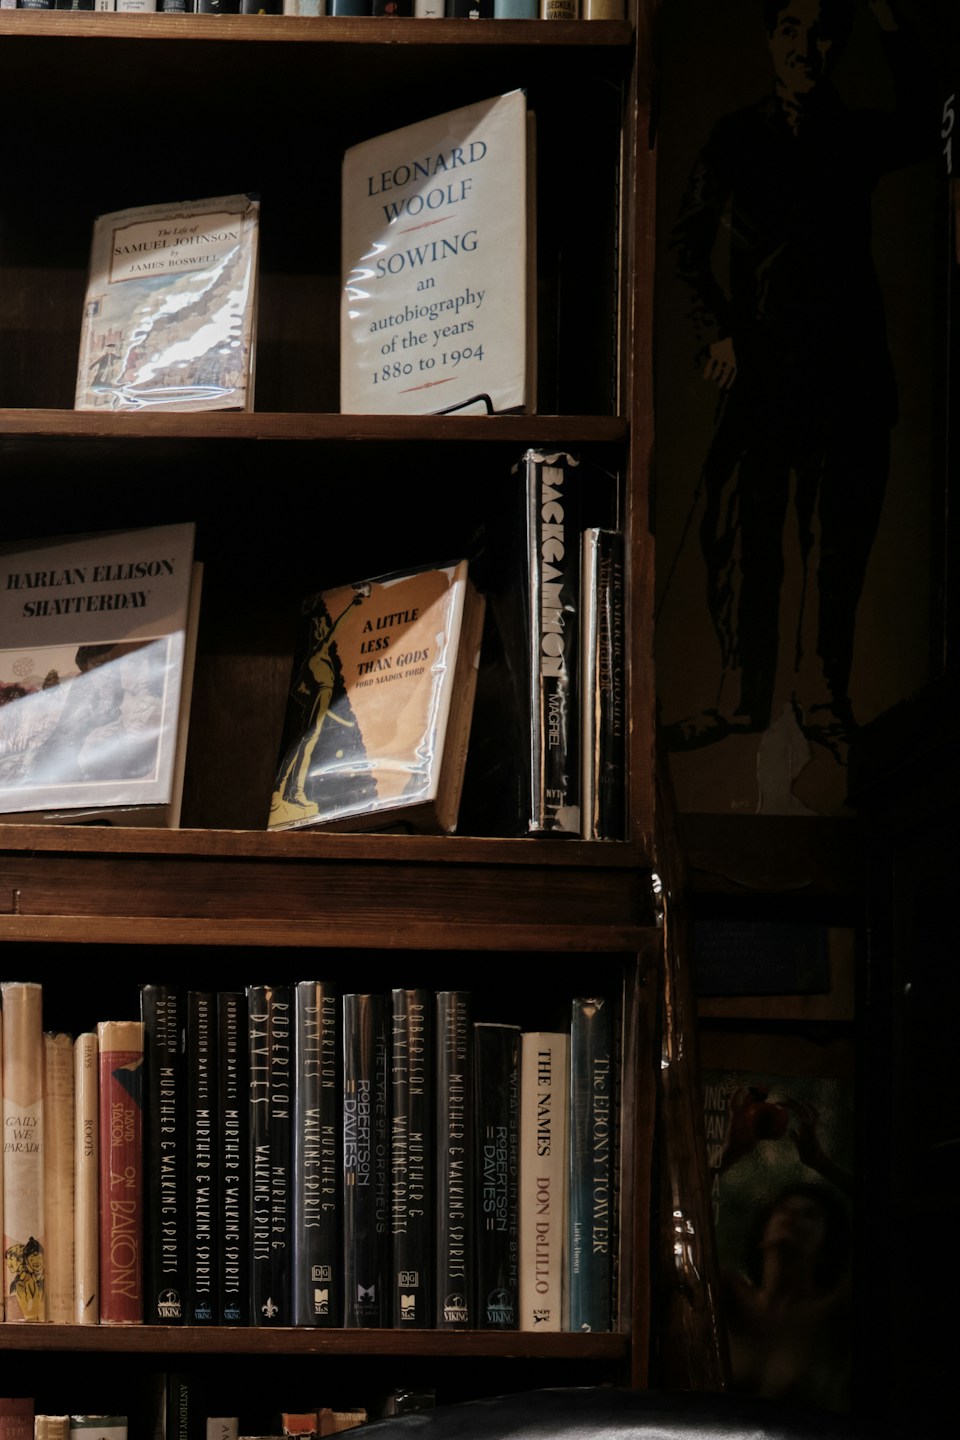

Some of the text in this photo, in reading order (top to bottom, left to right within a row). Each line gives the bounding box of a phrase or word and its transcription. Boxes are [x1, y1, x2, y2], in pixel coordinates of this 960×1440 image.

[367, 141, 488, 197] LEONARD
[382, 178, 473, 225] WOOLF
[114, 232, 238, 256] SAMUEL JOHNSON
[158, 229, 171, 237] The
[376, 230, 479, 279] SOWING
[130, 255, 220, 273] JAMES BOSWELL
[416, 277, 436, 292] an
[370, 287, 486, 333] autobiography
[381, 320, 475, 355] of the years
[372, 345, 485, 384] 1880 to 1904
[7, 559, 175, 590] HARLAN ELLISON
[23, 591, 150, 617] SHATTERDAY
[363, 608, 419, 633] A LITTLE
[358, 649, 429, 676] THAN GODS
[361, 636, 390, 654] LESS
[356, 667, 425, 688] FORD MADOX FORD
[548, 692, 561, 750] MAGRIEL
[250, 1014, 269, 1104] DAVIES
[272, 1002, 289, 1119] ROBERTSON
[322, 997, 336, 1088] ROBERTSON
[124, 1110, 135, 1141] DAVID
[304, 1109, 320, 1167] WALKING
[160, 1067, 177, 1274] MURTHER WALKING SPIRITS
[535, 1049, 551, 1294] THE NAMES DON DeLILLO
[593, 1057, 610, 1253] The EBONY TOWER
[196, 1110, 210, 1293] MURTHER WALKING SPIRITS
[254, 1144, 270, 1260] WALKING SPIRITS
[449, 1159, 464, 1278] WALKING SPIRITS
[110, 1199, 138, 1298] BALCONY
